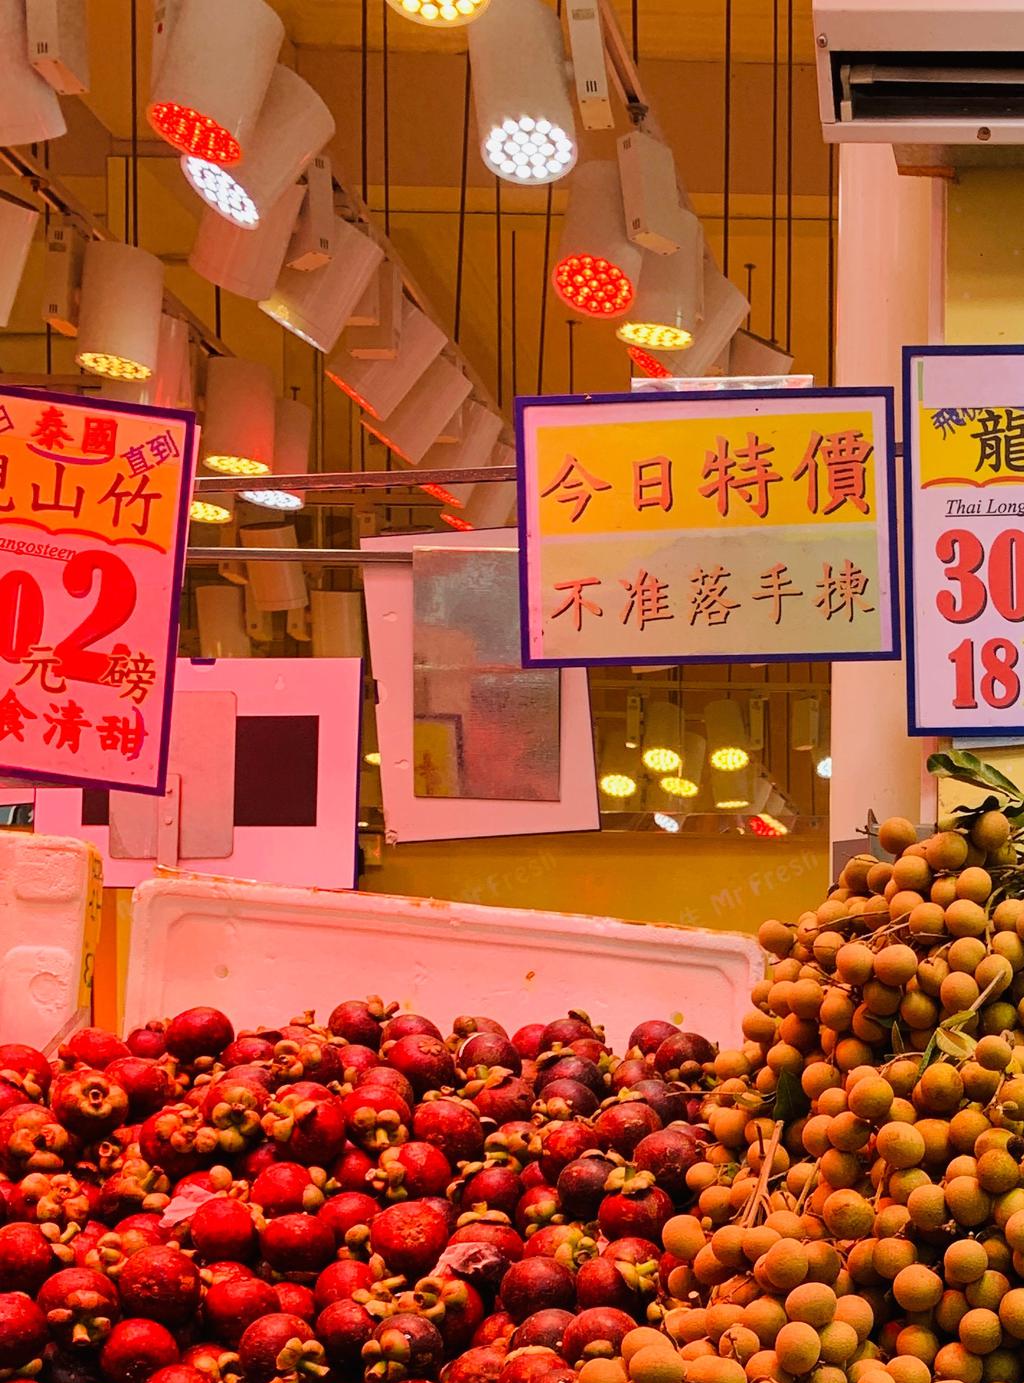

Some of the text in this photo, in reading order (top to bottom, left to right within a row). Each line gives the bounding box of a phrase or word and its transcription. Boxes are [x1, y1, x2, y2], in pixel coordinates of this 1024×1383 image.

[31, 406, 117, 455] 泰國
[120, 430, 179, 478] 直到
[540, 430, 875, 523] 今日特價
[946, 499, 982, 515] Thai
[747, 848, 820, 897] Fresh
